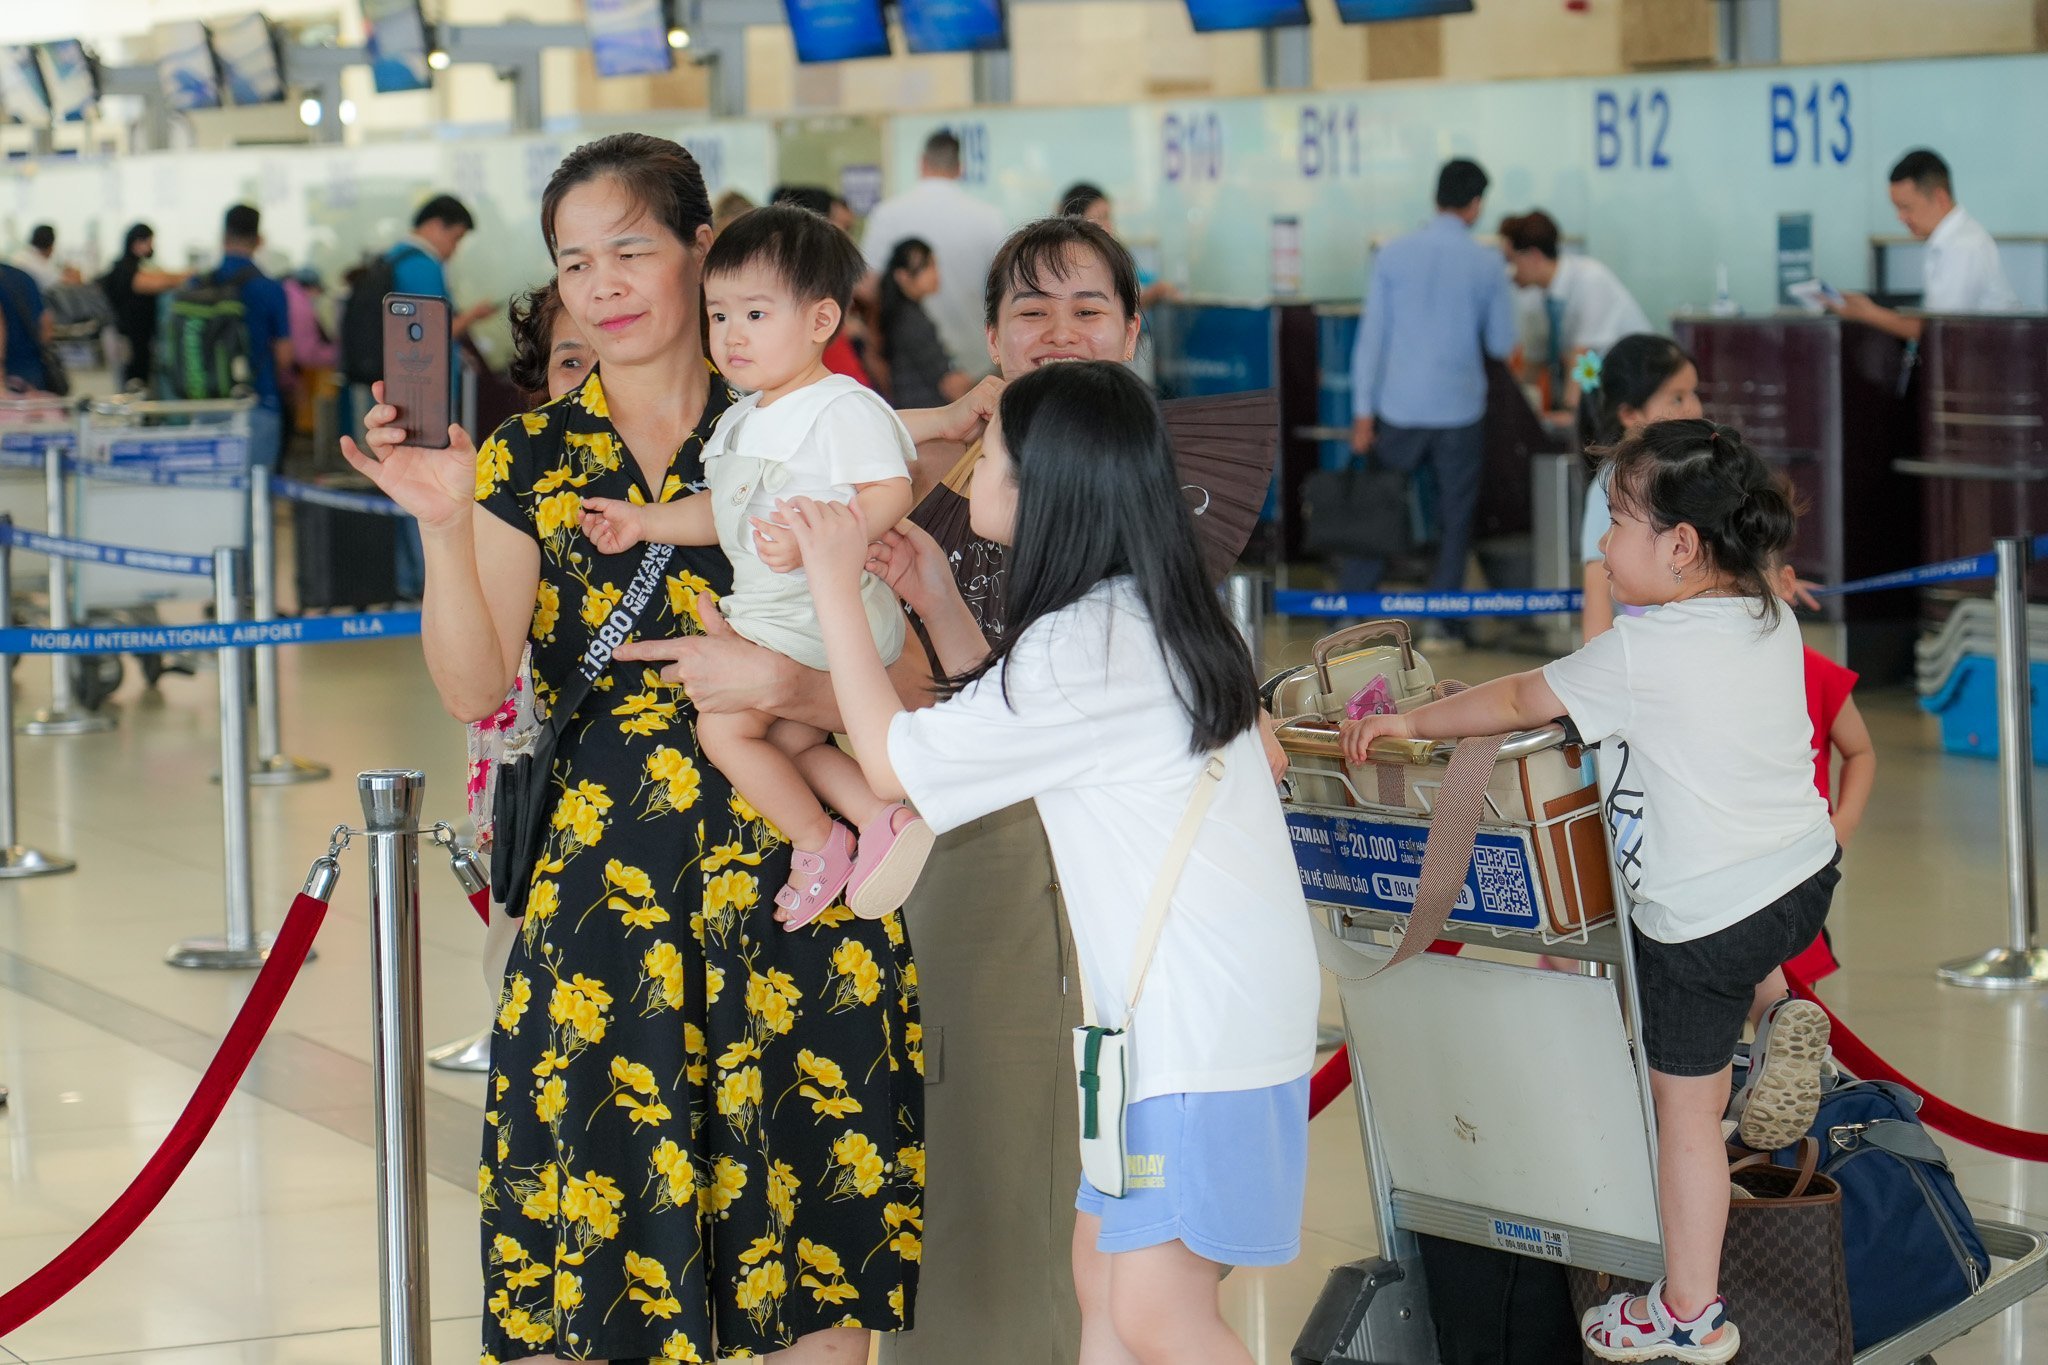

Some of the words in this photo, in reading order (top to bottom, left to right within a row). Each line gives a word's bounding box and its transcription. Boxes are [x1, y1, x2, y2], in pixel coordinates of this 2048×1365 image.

[1595, 88, 1670, 168] B12
[1771, 78, 1853, 166] B13
[1300, 105, 1360, 176] B11
[31, 633, 89, 649] NOIBAI
[94, 626, 227, 648] INTERNATIONAL
[232, 622, 303, 643] AIRPORT
[1289, 825, 1330, 845] IZMAN
[1349, 832, 1397, 862] 20.000
[1299, 866, 1312, 886] ÊN
[1352, 875, 1369, 894] CÁO
[1494, 1220, 1542, 1243] BIZMAN
[1546, 1245, 1563, 1257] 3716
